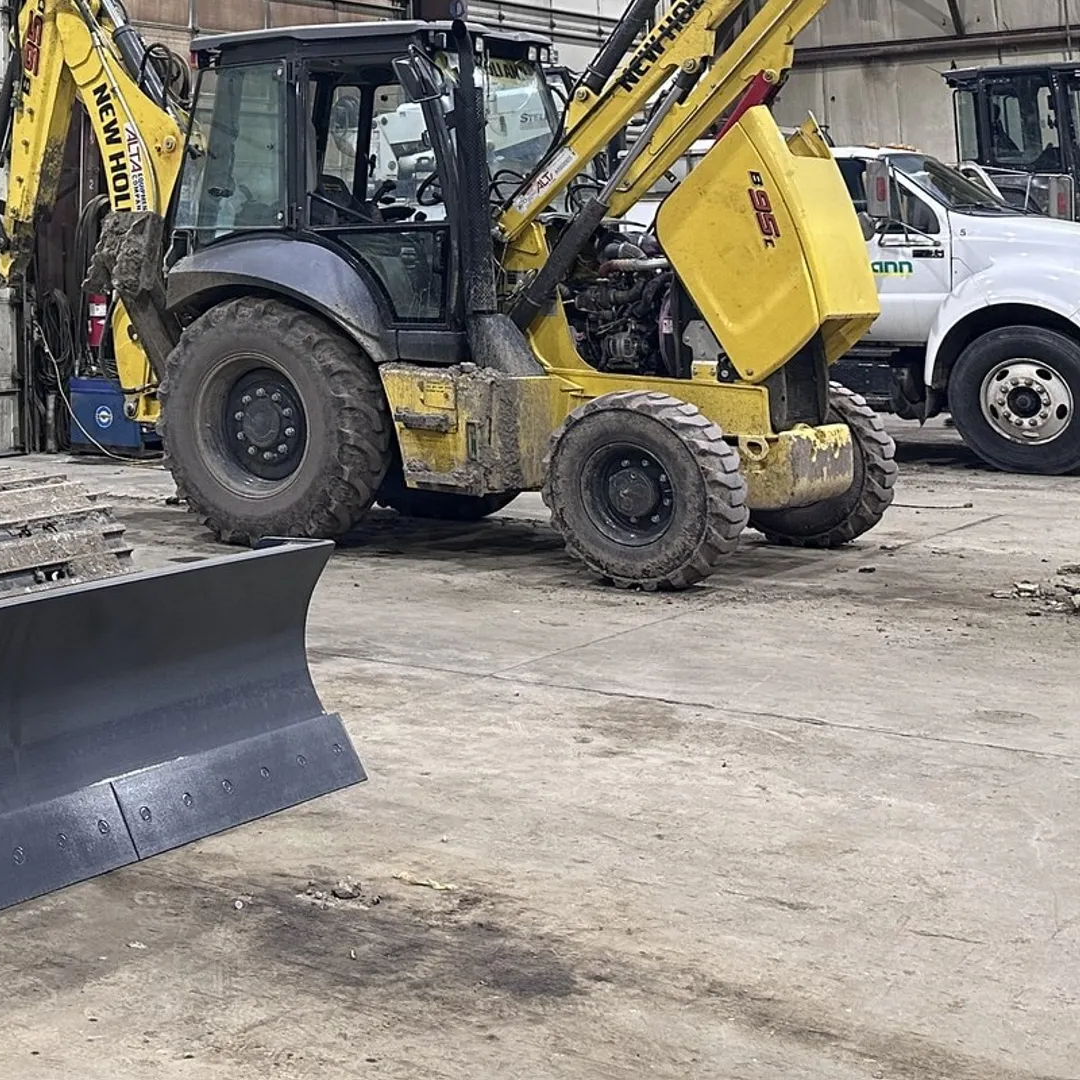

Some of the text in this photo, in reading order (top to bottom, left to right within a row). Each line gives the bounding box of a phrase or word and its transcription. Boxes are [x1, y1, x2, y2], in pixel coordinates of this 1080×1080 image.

[617, 36, 666, 93] NEW
[92, 82, 122, 146] NEW
[125, 127, 143, 173] ALTA
